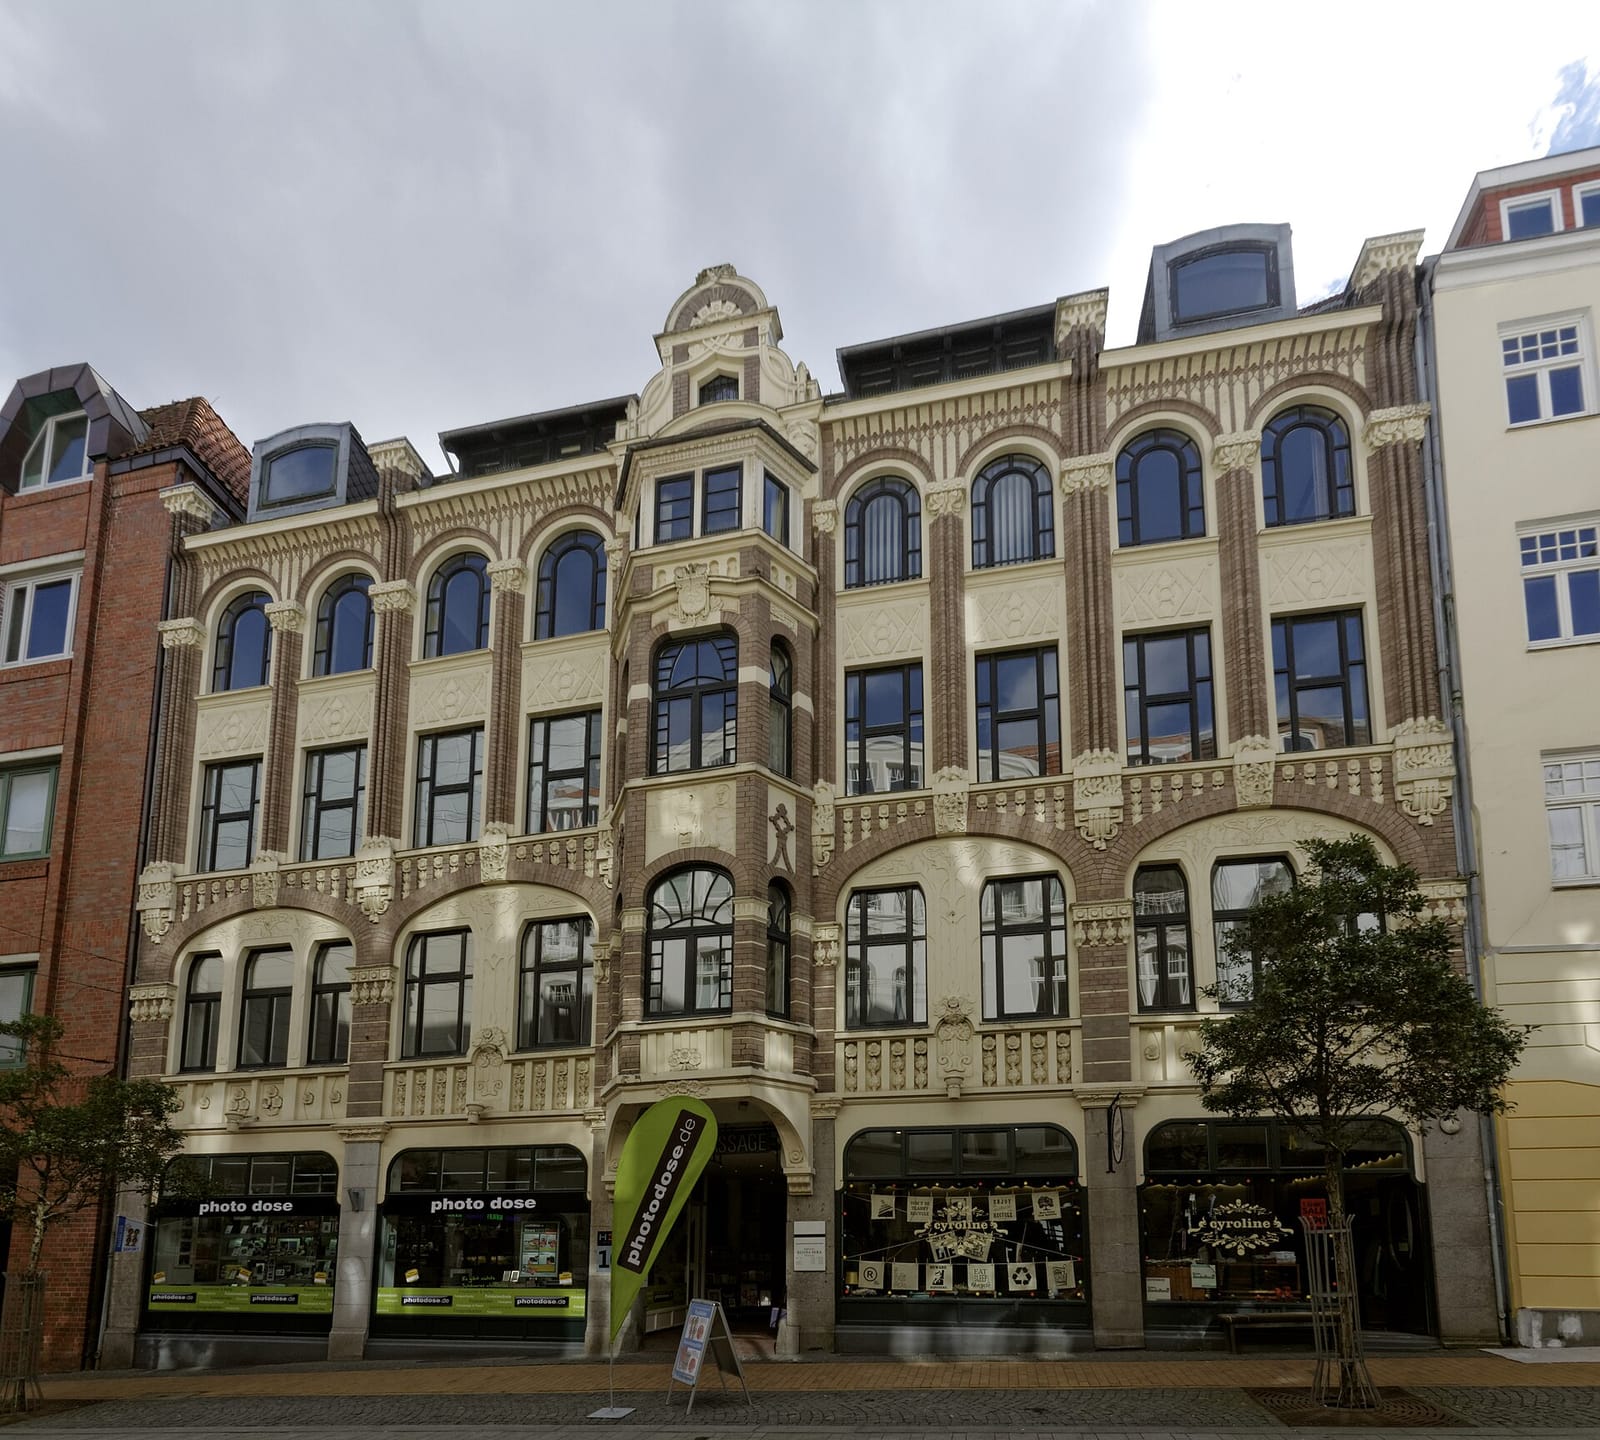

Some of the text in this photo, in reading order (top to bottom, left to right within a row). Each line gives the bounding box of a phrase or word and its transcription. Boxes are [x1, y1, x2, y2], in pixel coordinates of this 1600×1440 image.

[715, 1133, 767, 1152] SSAGE
[627, 1118, 696, 1267] photodose.de
[199, 1200, 294, 1215] photo dose
[430, 1196, 537, 1214] photo dose
[934, 1221, 988, 1232] cyroline
[1209, 1218, 1271, 1231] cyroline
[403, 1296, 450, 1304] photodose.de
[516, 1297, 566, 1305] photodose.de
